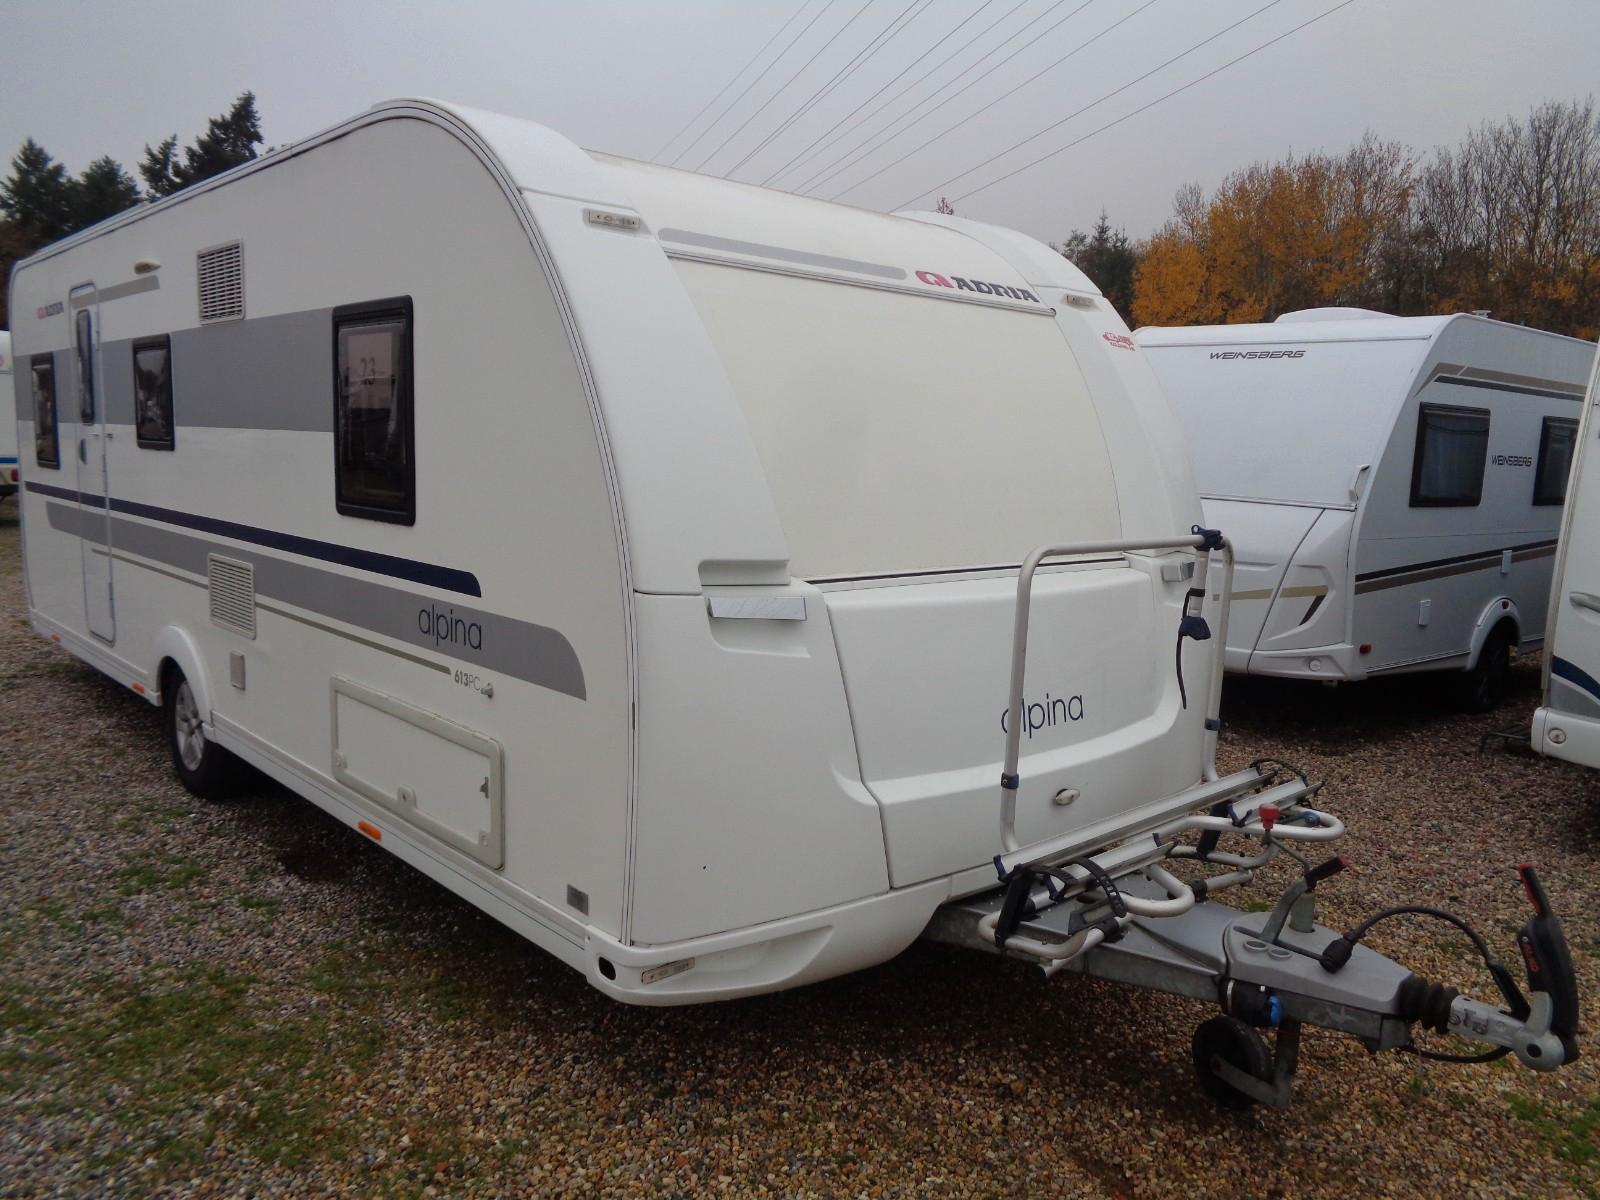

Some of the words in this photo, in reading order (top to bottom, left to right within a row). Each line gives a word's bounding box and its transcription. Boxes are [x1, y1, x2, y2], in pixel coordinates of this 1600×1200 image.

[950, 276, 1041, 303] ADRIA
[1209, 350, 1306, 360] WEINSBERG
[1491, 455, 1532, 467] WEINSBERG
[418, 603, 482, 651] alpina
